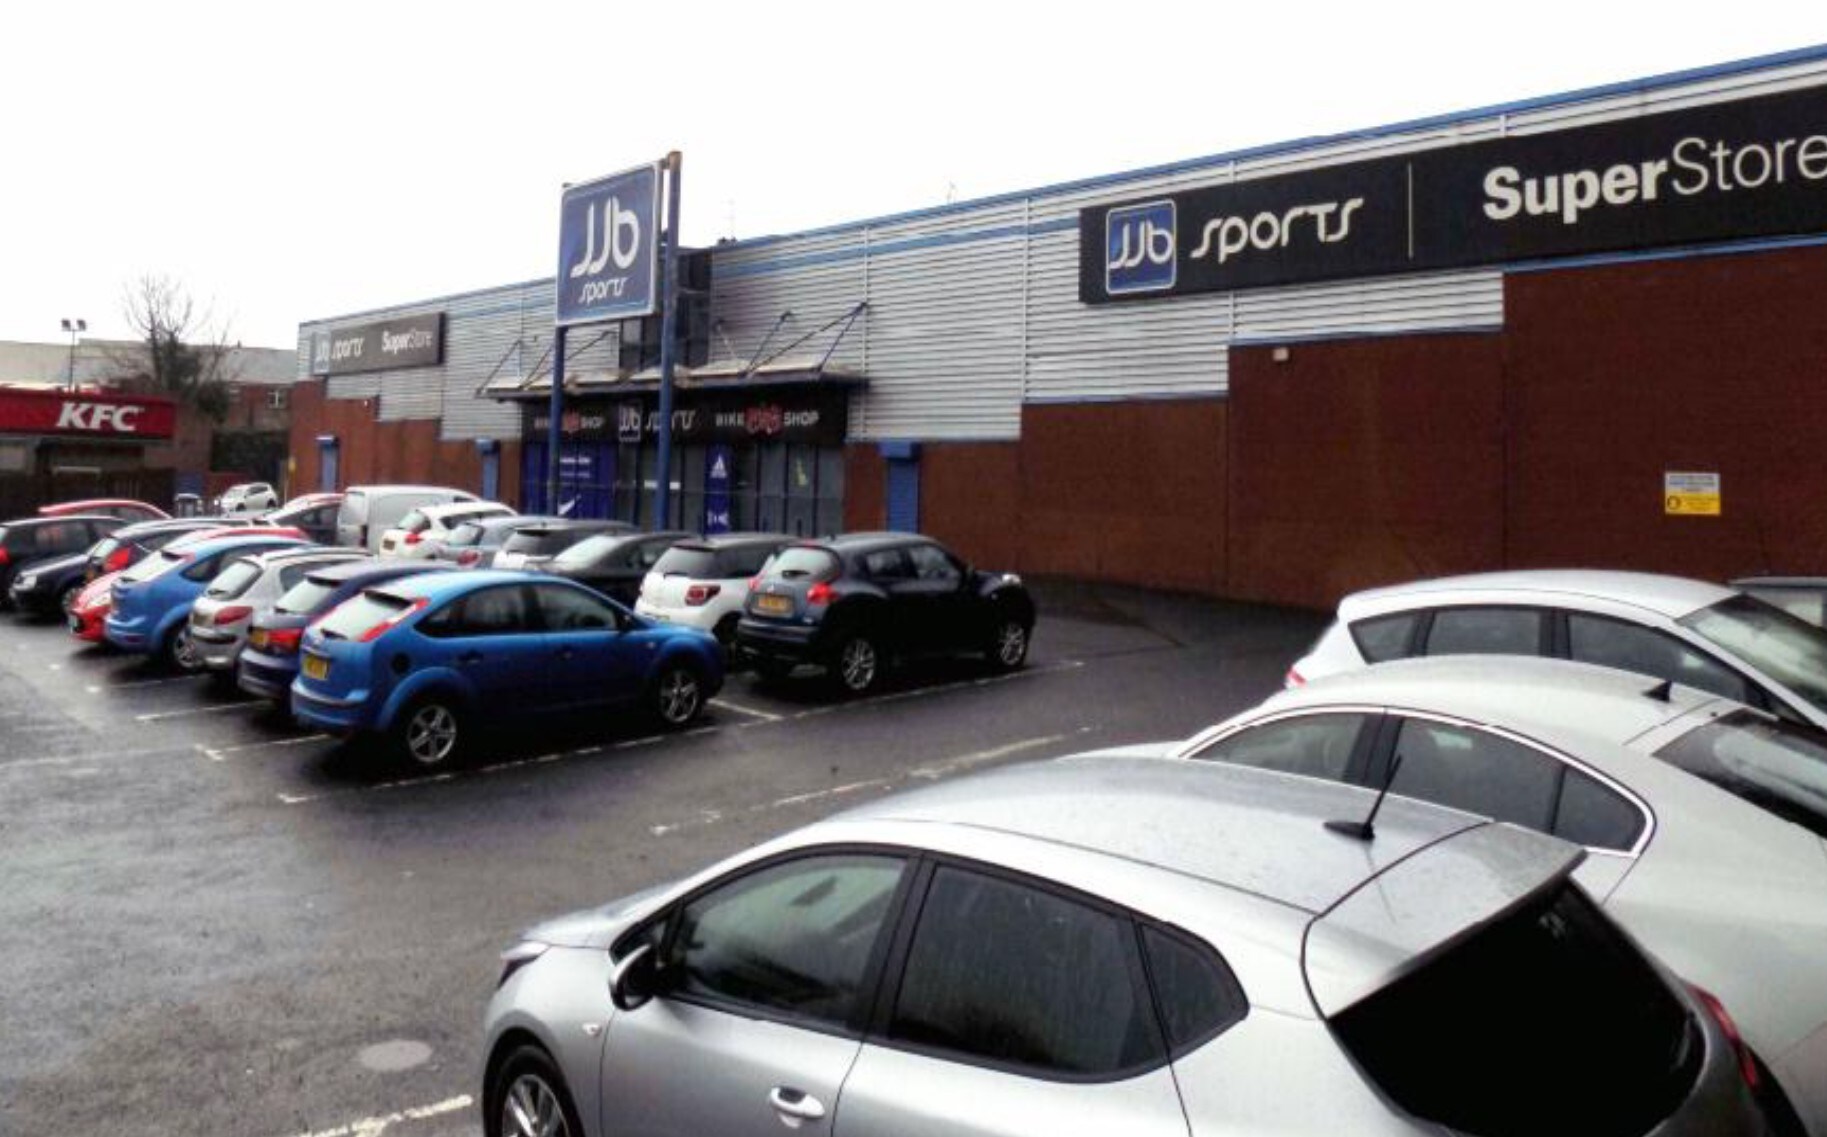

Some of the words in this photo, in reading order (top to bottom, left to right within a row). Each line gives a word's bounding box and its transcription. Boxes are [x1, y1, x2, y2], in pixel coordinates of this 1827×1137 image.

[1190, 198, 1364, 264] sports
[1482, 135, 1827, 224] SuperStore
[56, 402, 137, 432] KFC
[783, 410, 819, 427] SHOP
